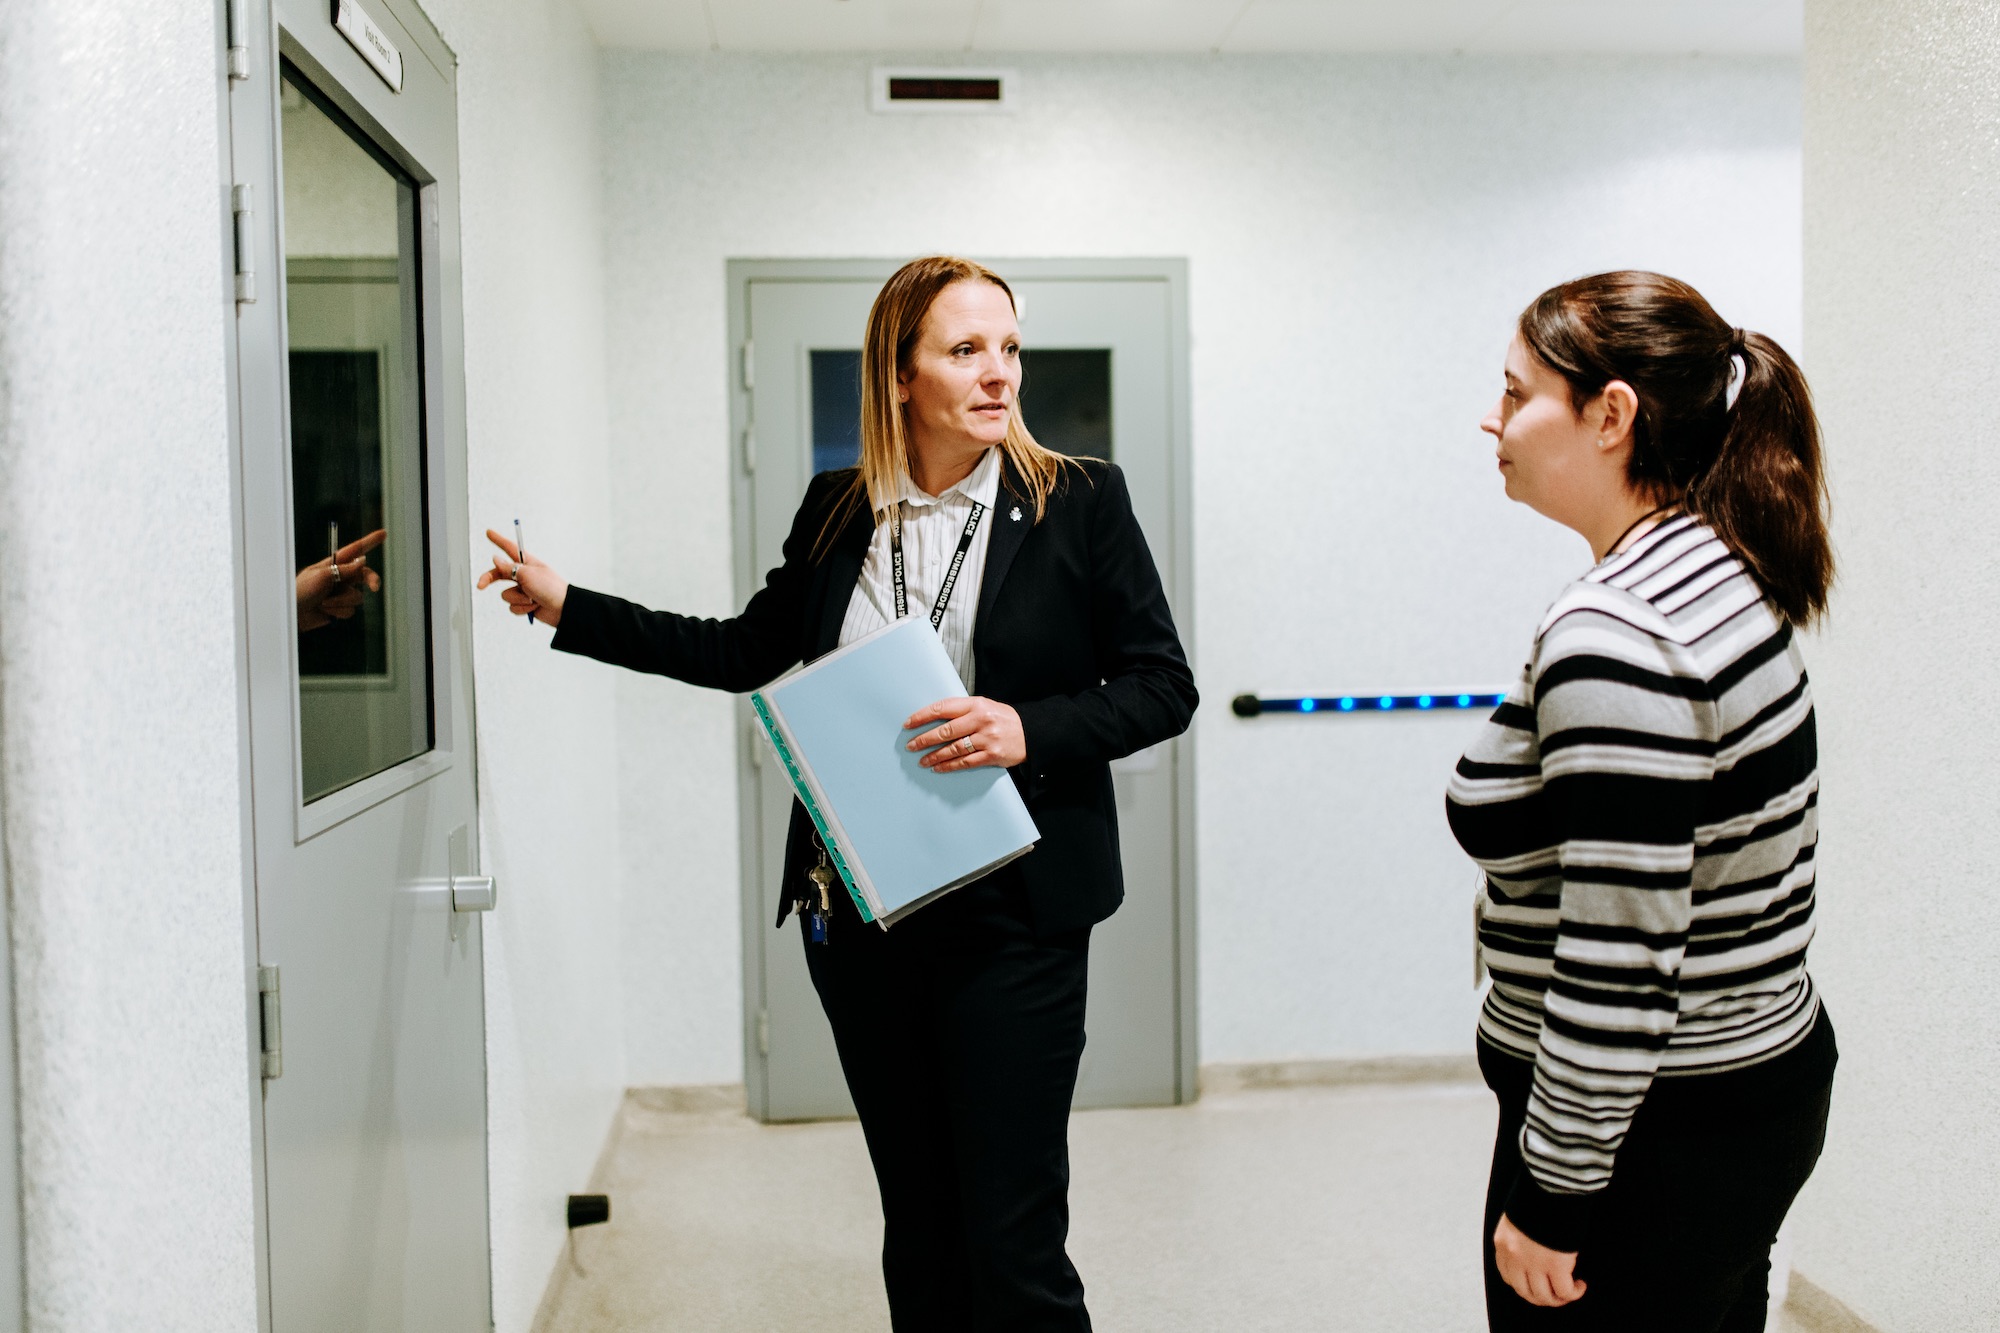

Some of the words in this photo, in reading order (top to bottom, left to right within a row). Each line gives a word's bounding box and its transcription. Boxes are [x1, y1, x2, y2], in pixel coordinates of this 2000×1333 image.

[364, 22, 375, 46] Visit
[375, 36, 387, 60] Room
[965, 504, 982, 536] POLICE
[894, 551, 903, 583] POLICE
[937, 551, 965, 609] HUMBERSIDE
